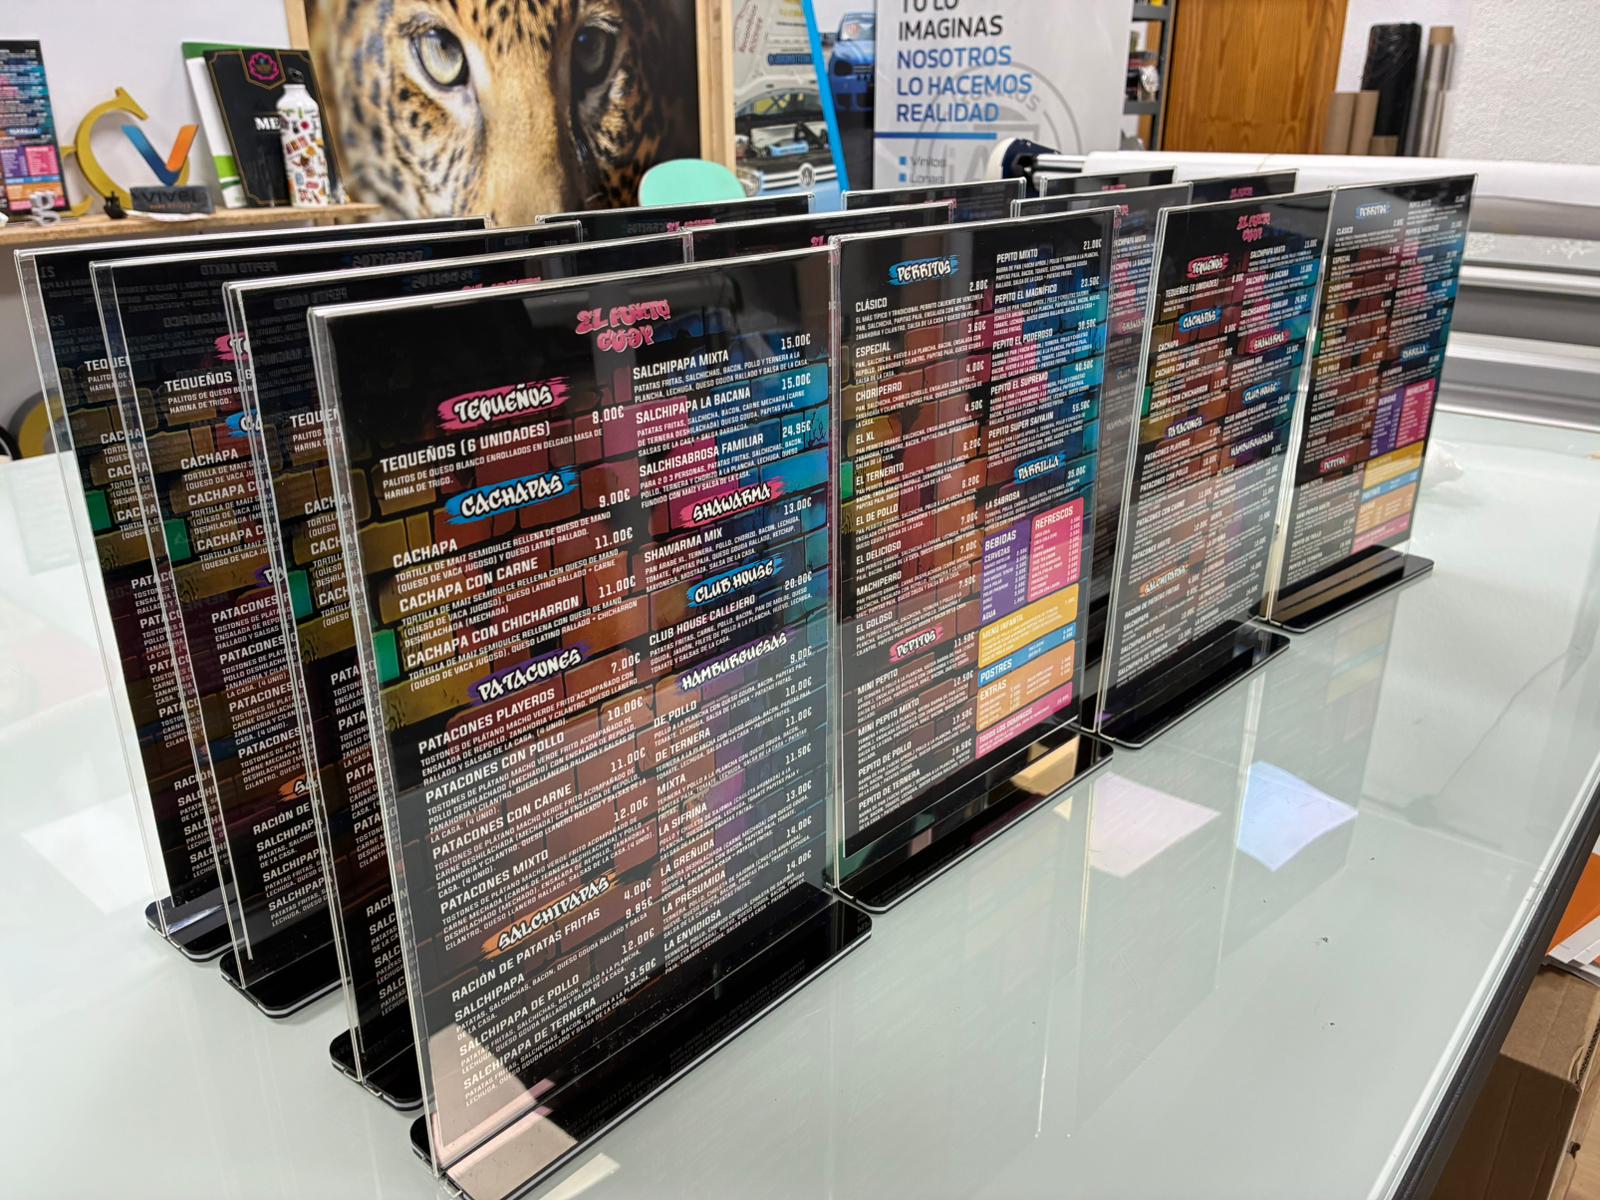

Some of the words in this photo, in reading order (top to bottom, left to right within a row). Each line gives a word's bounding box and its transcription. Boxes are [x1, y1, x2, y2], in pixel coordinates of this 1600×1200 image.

[899, 15, 1003, 41] IMAGINAS
[897, 46, 1012, 69] NOSOTROS
[897, 77, 923, 96] LO
[928, 74, 1033, 95] HACEMOS
[896, 103, 999, 122] REALIDAD
[897, 260, 951, 282] PERRITOS
[997, 253, 1018, 263] PEPITO
[1019, 250, 1038, 260] MIXTO
[855, 297, 887, 312] CLÁSICO
[633, 356, 697, 380] SALCHIPAPA
[699, 350, 729, 367] MIXTA
[781, 334, 811, 350] 15.00€
[856, 341, 891, 358] ESPECIAL
[164, 371, 232, 392] TEQUEÑOS
[636, 399, 698, 424] SALCHIPAPA
[700, 396, 712, 409] LA
[714, 388, 750, 406] BACANA
[782, 373, 811, 390] 15.00€
[856, 382, 902, 402] CHORIPERRO
[454, 384, 553, 422] TEQUEÑOS
[380, 442, 456, 473] TEQUEÑOS
[461, 438, 476, 457] (6
[480, 421, 550, 451] UNIDADES)
[592, 405, 625, 425] 8.00€
[639, 445, 719, 477] SALCHISABROSA
[721, 434, 764, 455] FAMILIAR
[782, 420, 812, 438] 24.95€
[856, 434, 864, 445] EL
[866, 432, 875, 441] XL
[180, 448, 239, 470] CACHAPA
[383, 472, 415, 489] PALITOS
[417, 469, 428, 480] DE
[429, 463, 455, 477] QUESO
[456, 456, 485, 471] BLANCO
[486, 445, 531, 464] ENROLLADOS
[533, 442, 542, 452] EN
[543, 435, 573, 450] DELGADA
[856, 476, 864, 486] EL
[866, 463, 904, 481] TERNERITO
[1018, 456, 1058, 480] PARRILLA
[188, 484, 245, 506] CACHAPA
[385, 486, 415, 500] HARINA
[417, 483, 427, 493] DE
[460, 474, 564, 519] CACHAPAS
[693, 484, 771, 522] SHAWARMA
[985, 501, 993, 510] LA
[994, 490, 1020, 507] SABROSA
[393, 538, 458, 569] CACHAPA
[598, 488, 631, 509] 9.00€
[644, 534, 702, 563] SHAWARMA
[704, 528, 723, 543] MIX
[784, 497, 812, 515] 13.00€
[856, 516, 864, 525] EL
[866, 513, 876, 522] DE
[877, 503, 898, 519] POLLO
[1035, 506, 1074, 530] REFRESCOS
[984, 530, 1017, 551] BEBIDAS
[399, 579, 463, 613] CACHAPA
[466, 570, 493, 592] CON
[496, 556, 539, 582] CARNE
[595, 527, 633, 550] 11.00€
[694, 579, 731, 604] CLUB
[732, 561, 774, 588] HOUSE
[856, 571, 902, 596] MACHIPERRO
[211, 595, 278, 623] PATACONES
[404, 622, 464, 649] DESHILACHADA
[466, 605, 509, 628] (MECHADA)
[407, 633, 468, 669] CACHAPA
[472, 623, 498, 646] CON
[502, 595, 580, 635] CHICHARRON
[598, 576, 636, 598] 11.00€
[649, 626, 674, 646] CLUB
[676, 613, 708, 635] HOUSE
[710, 595, 756, 622] CALLEJERO
[784, 571, 813, 590] 20.00€
[856, 624, 864, 634] EL
[866, 612, 893, 629] GOLOSO
[220, 634, 285, 664] PATACONES
[682, 633, 787, 691] HAMBURGUESAS
[896, 630, 936, 657] PEPITOS
[477, 649, 582, 701] PATACONES
[654, 714, 667, 729] DE
[668, 700, 697, 723] POLLO
[790, 646, 813, 664] 9.00€
[980, 658, 1012, 683] POSTRES
[980, 679, 1007, 700] EXTRAS
[418, 713, 494, 755] PATACONES
[496, 689, 555, 724] PLAYEROS
[610, 652, 641, 674] 7.00€
[655, 747, 668, 762] DE
[670, 728, 711, 756] TERNERA
[785, 676, 812, 698] 10.00€
[425, 760, 499, 804] PATACONES
[501, 748, 526, 771] CON
[529, 732, 565, 759] POLLO
[607, 697, 644, 722] 10.00€
[657, 774, 686, 796] MIXTA
[785, 707, 812, 728] 11.00€
[858, 760, 881, 777] PEPITO
[882, 753, 891, 764] DE
[892, 741, 912, 759] POLLO
[432, 814, 504, 859] PATACONES
[507, 801, 531, 824] CON
[534, 783, 572, 812] CARNE
[610, 746, 646, 773] 11.00€
[658, 821, 670, 836] LA
[671, 803, 708, 829] SIFRINA
[785, 743, 812, 765] 11.50€
[253, 810, 293, 835] RACIÓN
[296, 802, 310, 814] DE
[660, 862, 672, 877] LA
[673, 838, 715, 870] GREÑUDA
[786, 780, 812, 802] 13.00€
[440, 868, 510, 915] PATACONES
[513, 849, 549, 878] MIXTO
[614, 797, 648, 822] 12.00€
[662, 901, 673, 916] LA
[675, 870, 726, 908] PRESUMIDA
[664, 937, 675, 951] LA
[676, 910, 722, 944] ENVIDIOSA
[786, 849, 812, 873] 14.00€
[497, 876, 610, 952] SALCHIPAPAS
[452, 966, 496, 1002] RACIÓN
[499, 956, 514, 975] DE
[516, 930, 562, 966] PATATAS
[564, 909, 601, 939] FRITAS
[623, 878, 652, 900] 4.00€
[454, 971, 525, 1022] SALCHIPAPA
[625, 896, 653, 920] 9.85€
[459, 1003, 528, 1056] SALCHIPAPA
[530, 993, 545, 1012] DE
[547, 972, 579, 1002] POLLO
[621, 928, 656, 955] 12.00€
[464, 1035, 532, 1088] SALCHIPAPA
[534, 1025, 548, 1045] DE
[550, 996, 596, 1035] TERNERA
[623, 958, 657, 985] 13.50€
